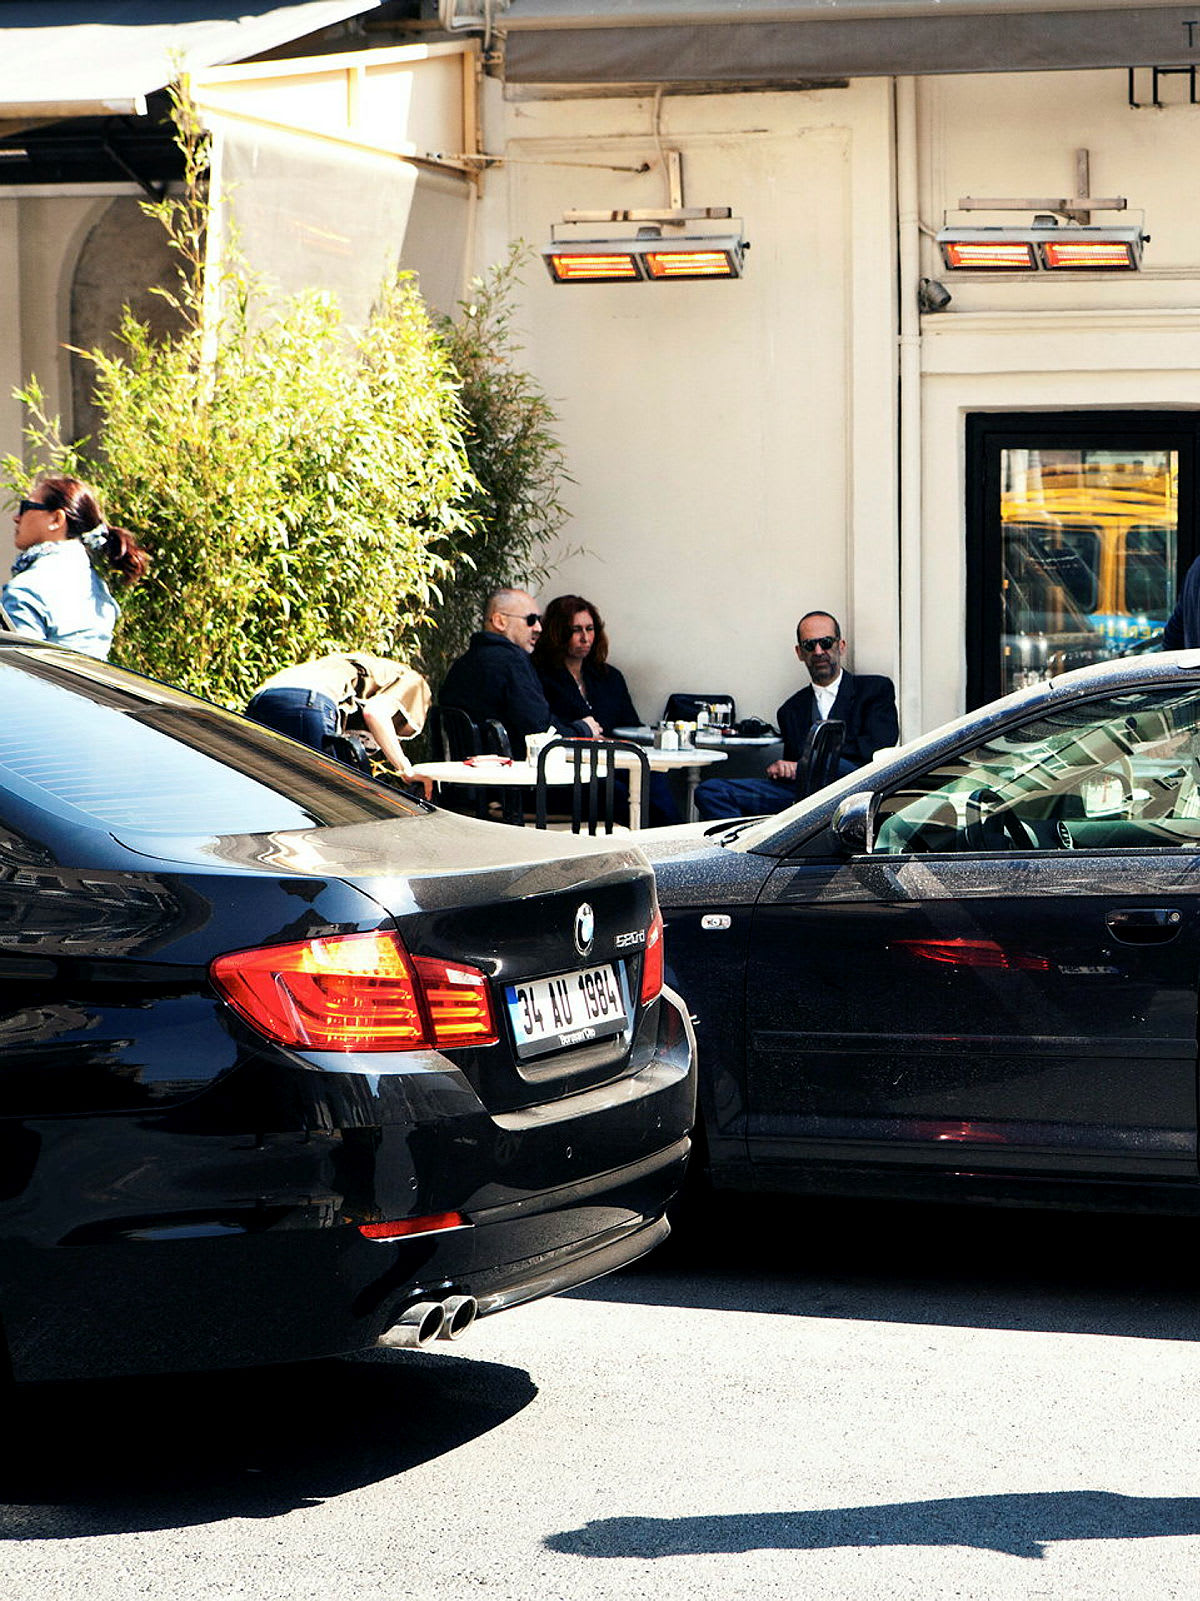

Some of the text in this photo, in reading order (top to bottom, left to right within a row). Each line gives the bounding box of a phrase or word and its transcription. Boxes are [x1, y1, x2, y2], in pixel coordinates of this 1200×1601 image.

[517, 969, 618, 1034] 34 AU 1984
